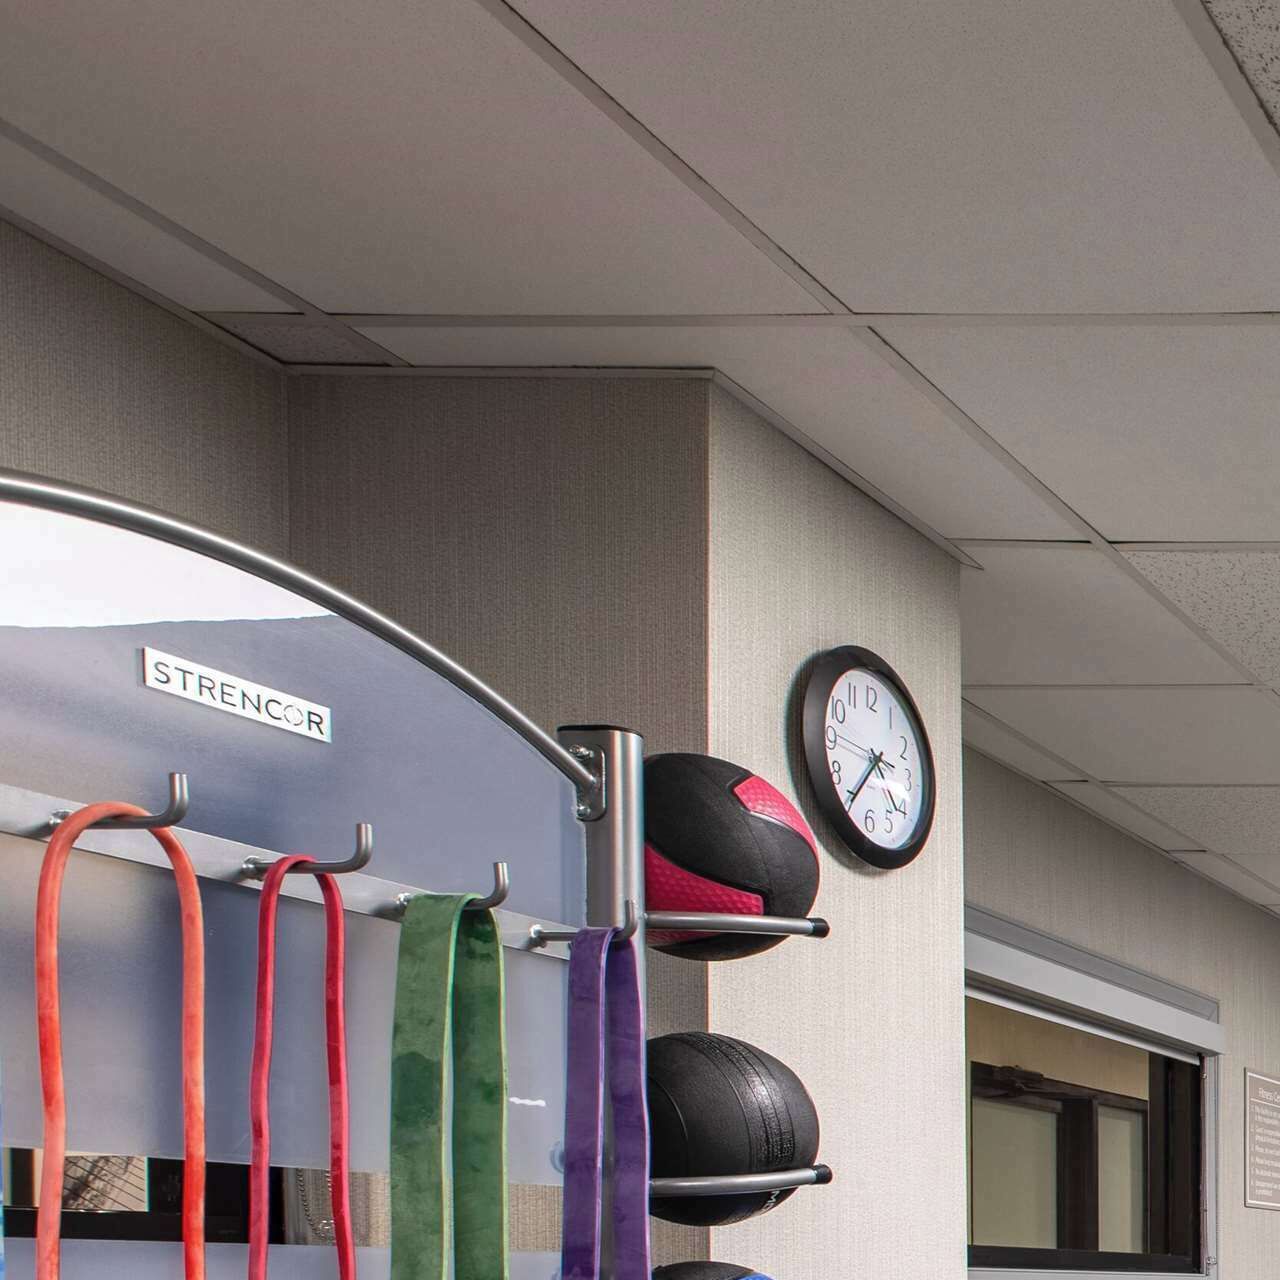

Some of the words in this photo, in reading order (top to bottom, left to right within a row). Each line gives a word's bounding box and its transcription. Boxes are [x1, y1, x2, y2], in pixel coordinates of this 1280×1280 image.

[154, 661, 325, 736] STRENCOR
[848, 682, 857, 709] 11
[865, 685, 878, 713] 12
[831, 695, 846, 724] 10
[826, 725, 837, 750] 9
[899, 735, 908, 760] 2
[831, 760, 842, 785] 8
[904, 768, 912, 791] 3
[864, 809, 875, 833] 6
[884, 809, 894, 833] 5
